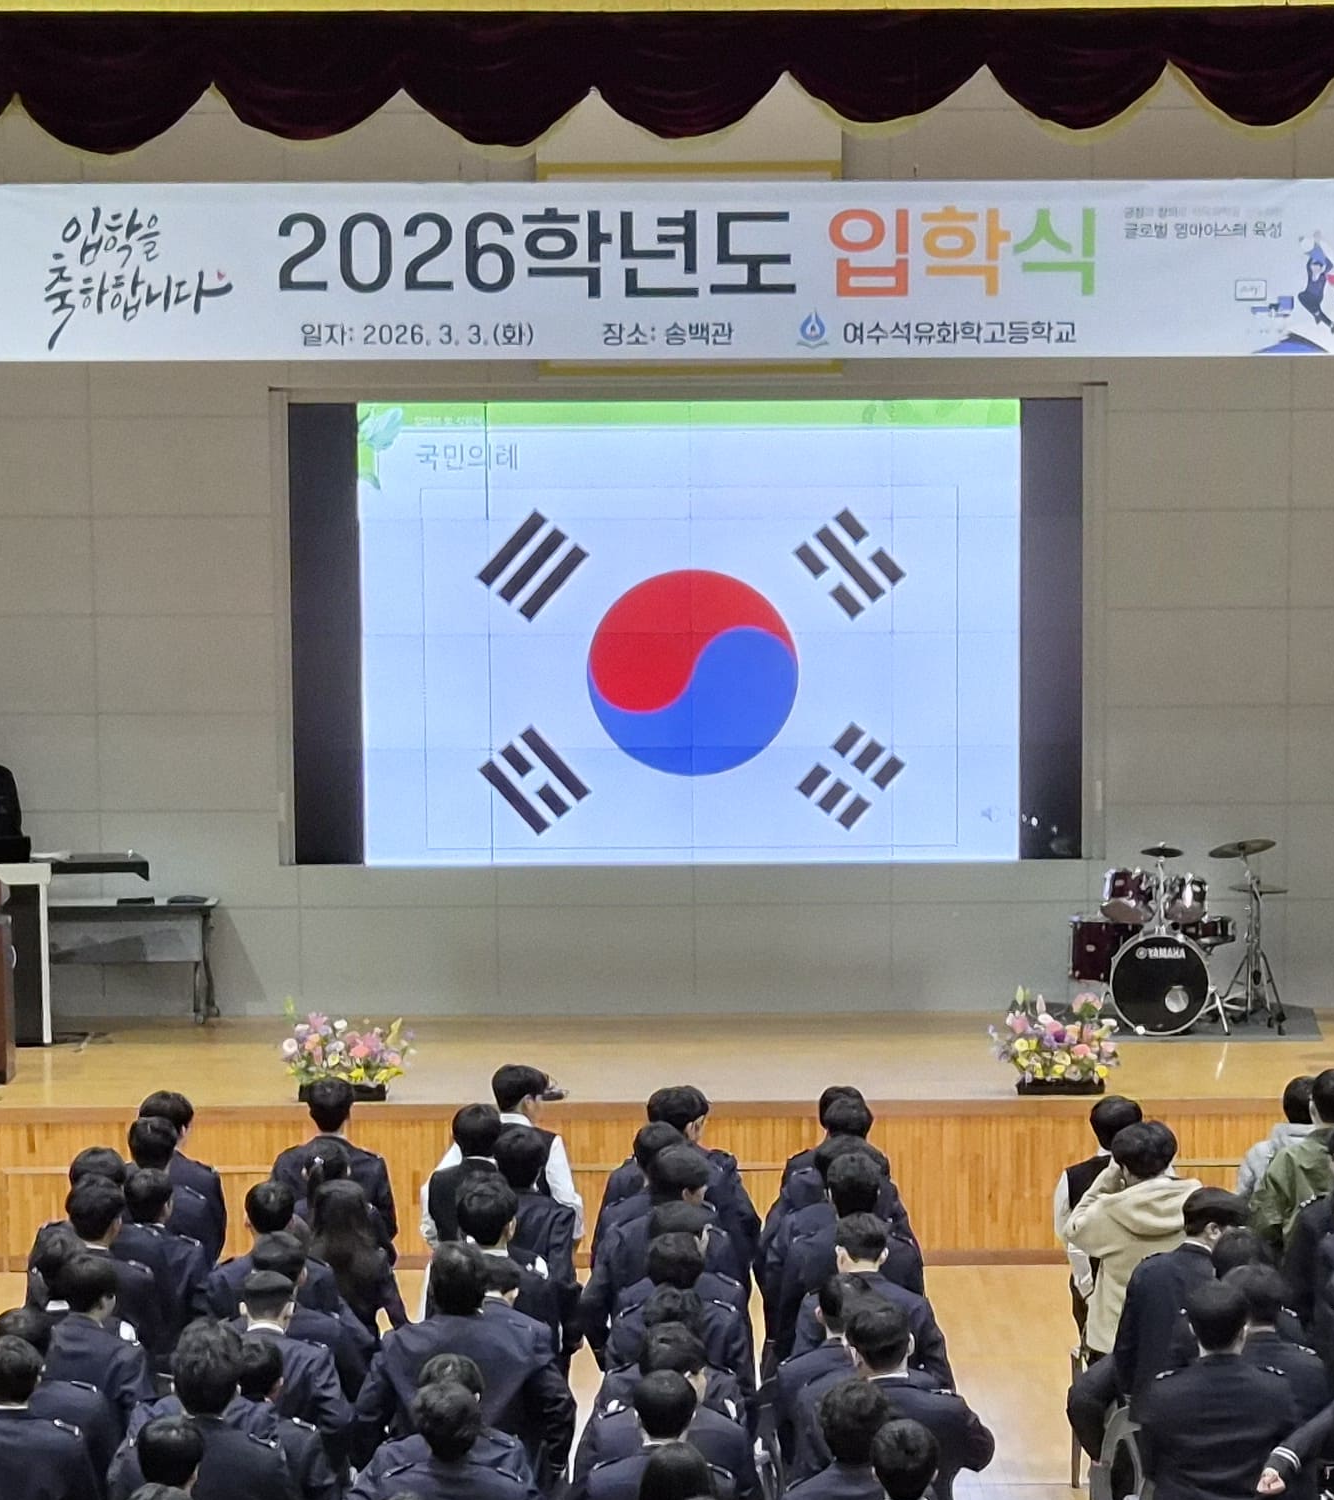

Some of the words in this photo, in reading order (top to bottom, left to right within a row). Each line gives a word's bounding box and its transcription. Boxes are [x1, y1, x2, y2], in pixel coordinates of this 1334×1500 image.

[61, 206, 162, 266] 입학을
[1124, 222, 1168, 238] 글로벌
[1252, 221, 1282, 238] 육성
[277, 209, 797, 299] 2026학년도
[827, 206, 1098, 298] 입학식
[43, 254, 235, 351] 축하합니다
[299, 322, 356, 349] 일자:
[362, 322, 432, 348] 2026.
[439, 322, 461, 348] 3.
[601, 321, 657, 348] 장소:
[664, 320, 734, 347] 송백관
[842, 319, 1078, 346] 여수석유화학고등학교
[415, 443, 518, 471] 국민의례
[1147, 947, 1186, 959] YAMAHA
